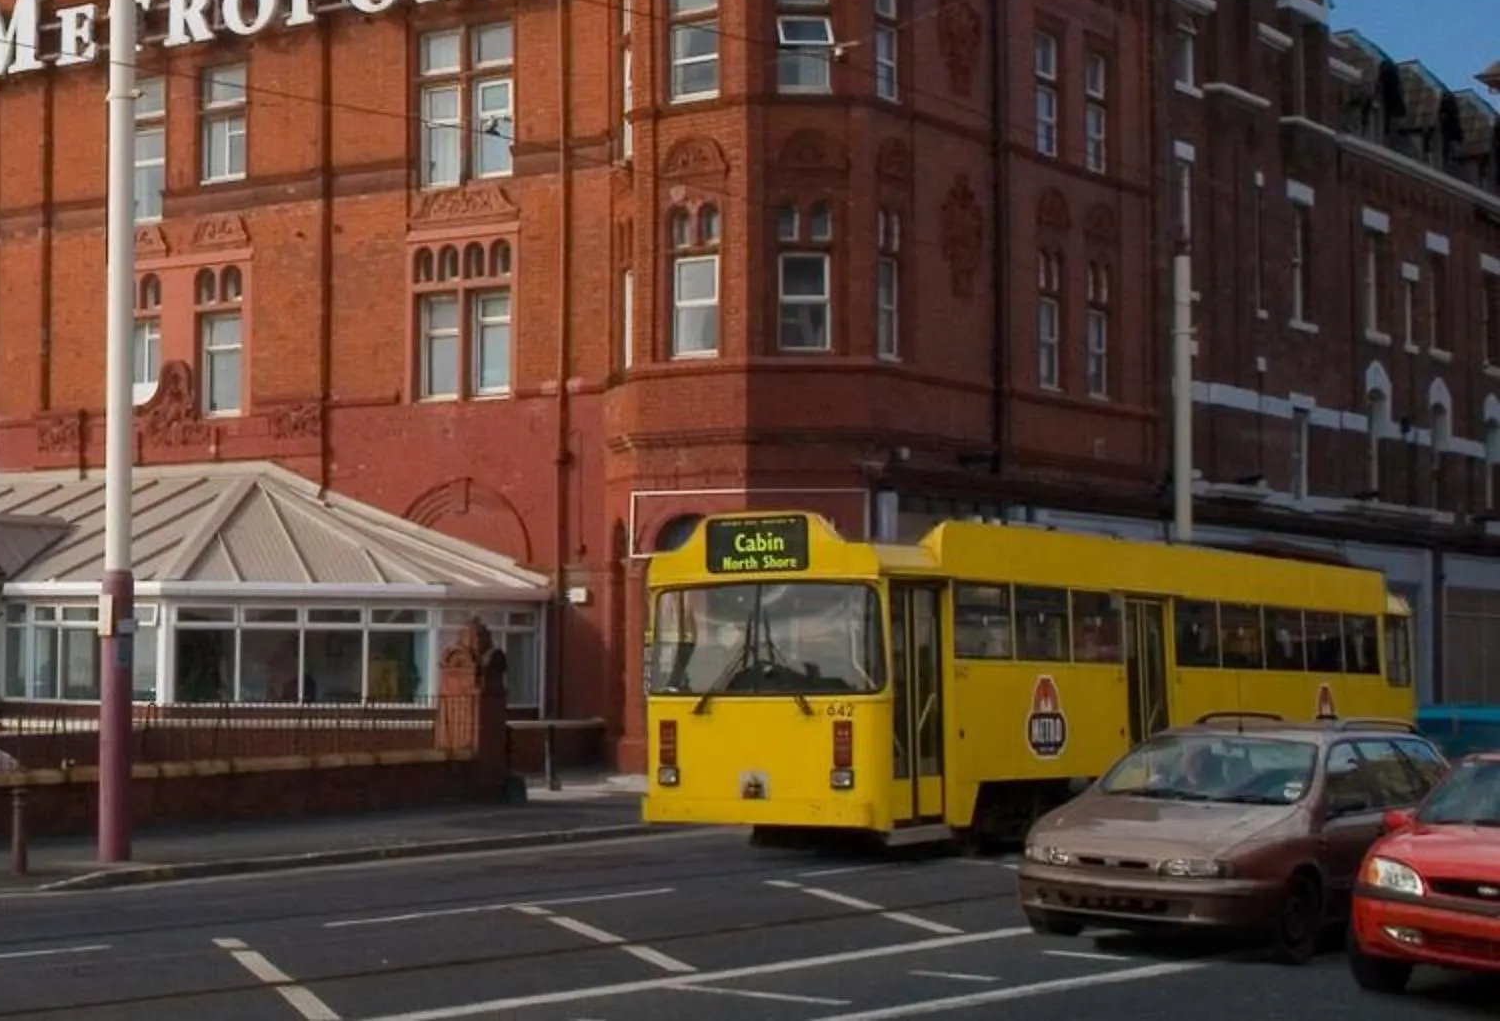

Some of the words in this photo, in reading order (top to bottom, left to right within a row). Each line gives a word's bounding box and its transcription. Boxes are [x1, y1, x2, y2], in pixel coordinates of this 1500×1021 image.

[734, 532, 784, 552] Cabin
[723, 555, 758, 570] North
[763, 554, 797, 569] Shore
